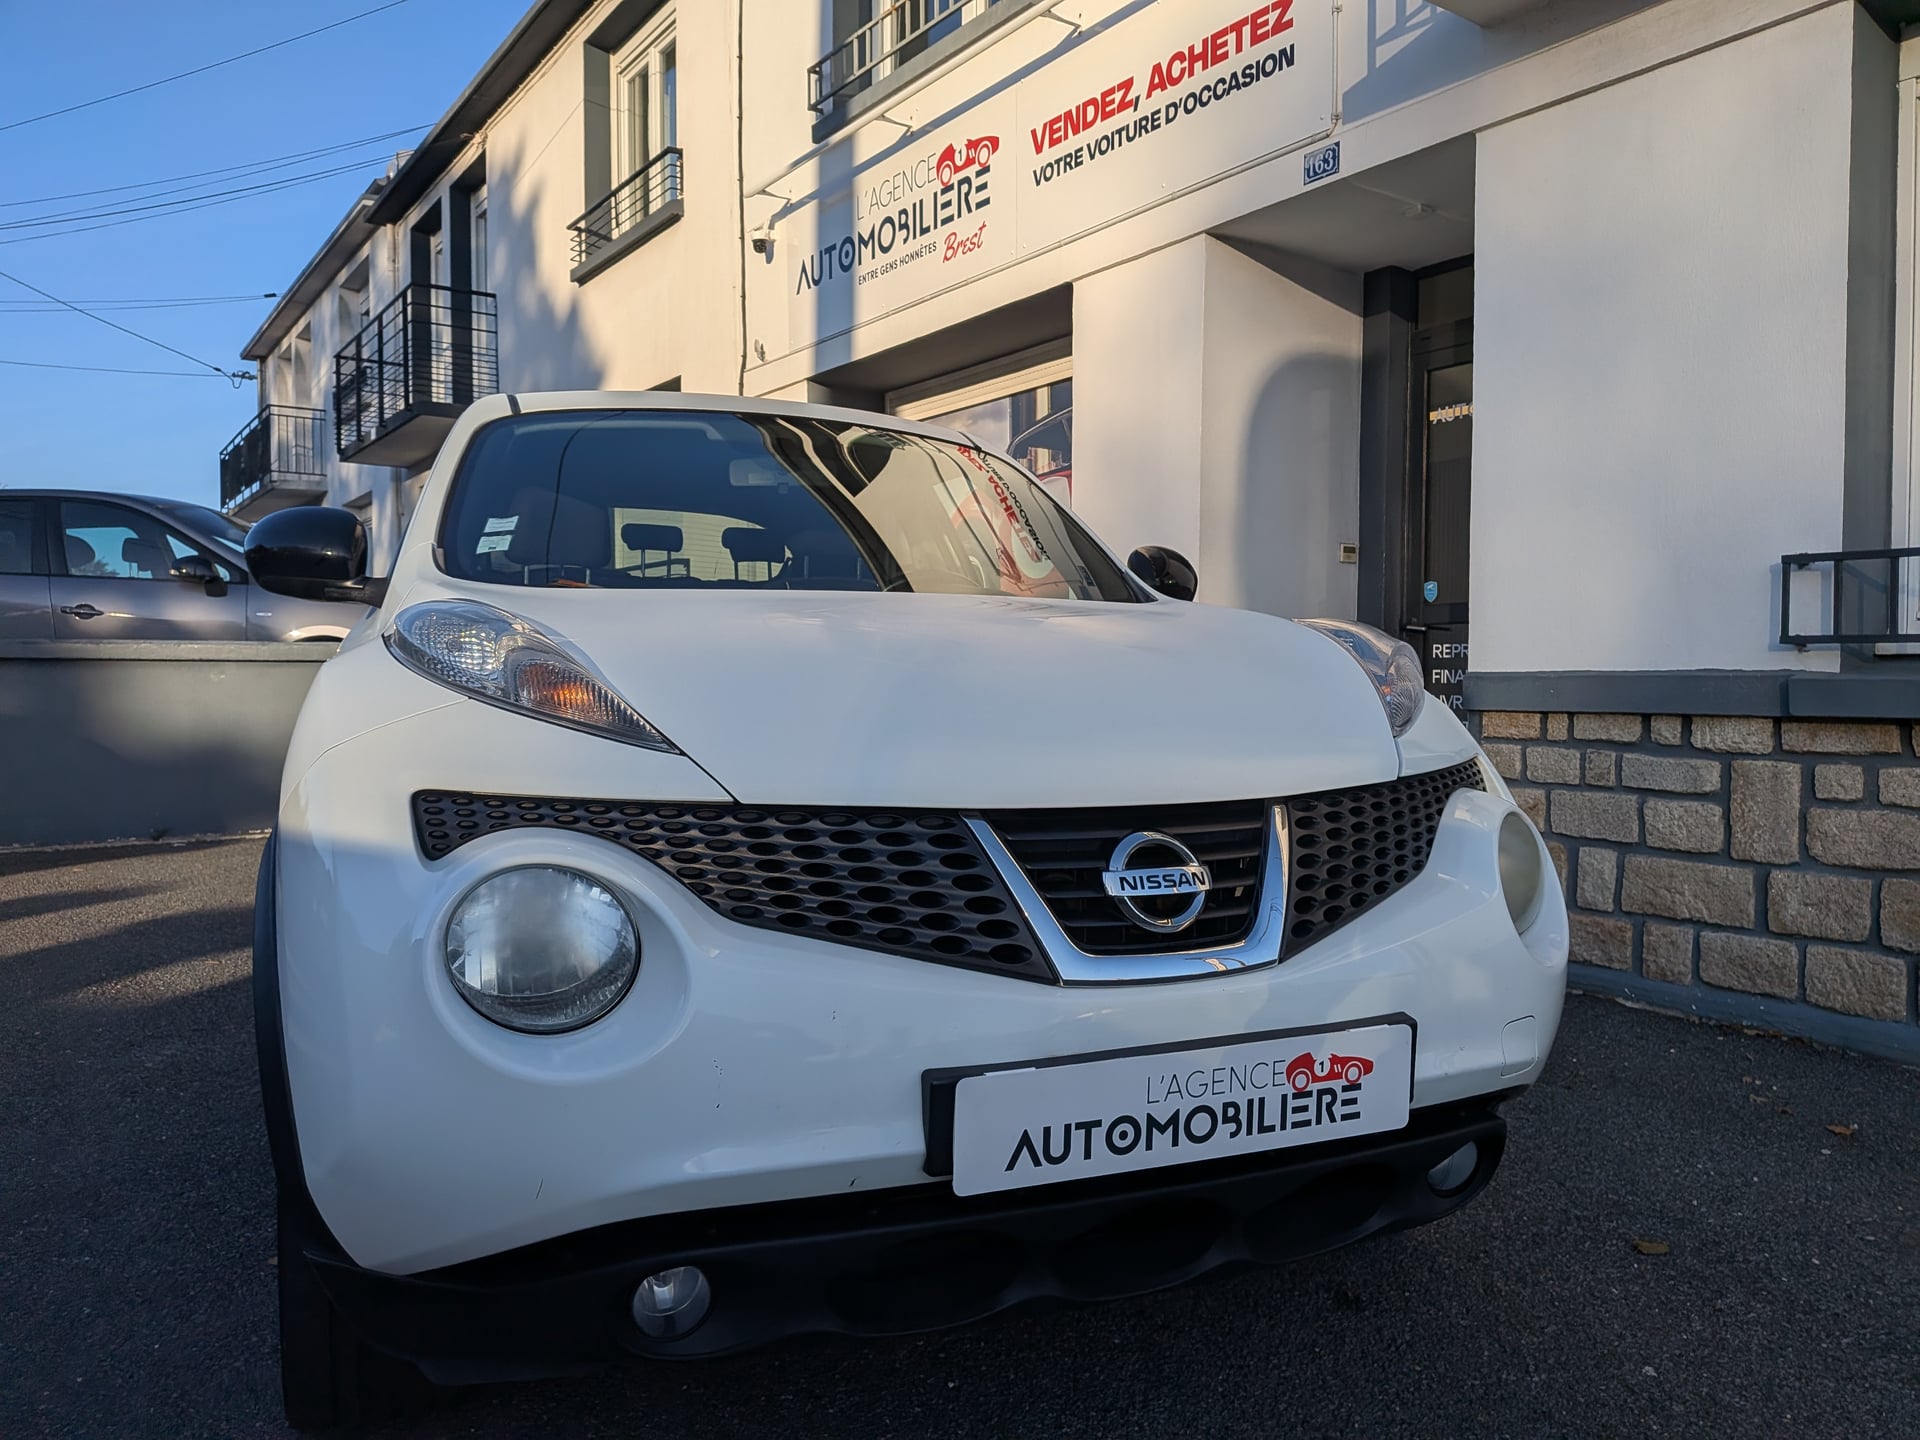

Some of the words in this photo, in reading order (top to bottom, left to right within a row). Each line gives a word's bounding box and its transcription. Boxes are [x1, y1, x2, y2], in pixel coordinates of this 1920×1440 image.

[1031, 76, 1140, 155] VENDEZ,
[1146, 0, 1294, 100] ACHETEZ
[1032, 146, 1084, 187] VOTRE
[1086, 107, 1162, 161] VOITURE
[1165, 43, 1295, 126] D'OCCASION
[1309, 150, 1334, 177] 163
[856, 152, 937, 221] L'AGENCE
[858, 267, 879, 286] ENTRE
[880, 259, 898, 276] GENS
[899, 241, 937, 267] HONNÊTES
[943, 221, 987, 264] Brest
[1432, 669, 1468, 684] FINA
[1119, 870, 1206, 892] NISSAN
[1146, 1059, 1286, 1104] L'AGENCE
